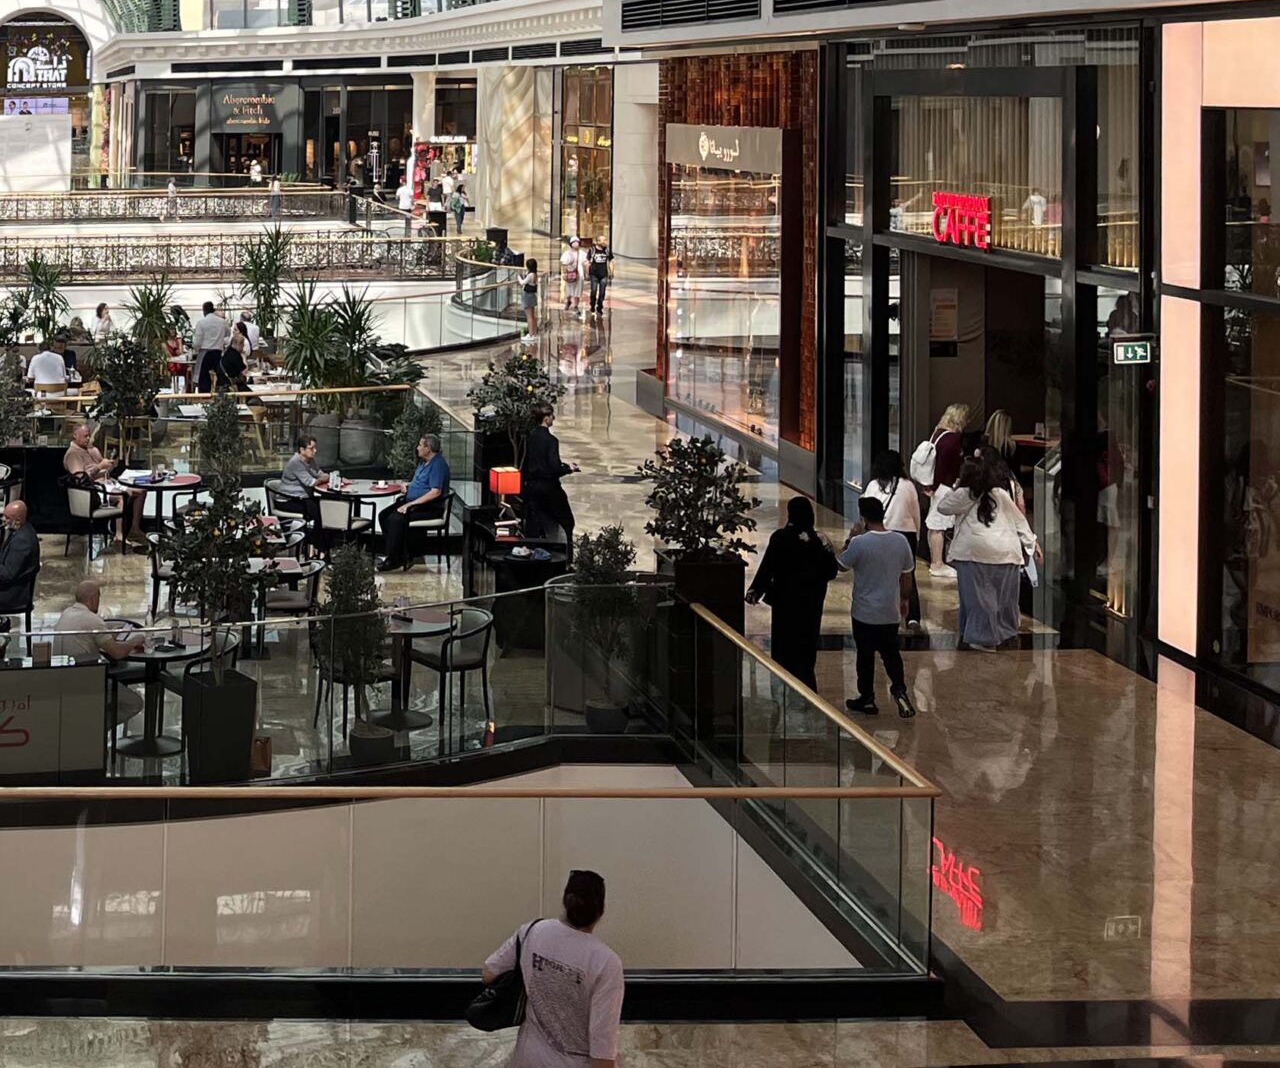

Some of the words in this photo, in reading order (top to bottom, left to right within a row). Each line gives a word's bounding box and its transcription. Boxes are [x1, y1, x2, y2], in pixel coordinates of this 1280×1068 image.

[36, 70, 67, 82] THAT
[223, 93, 276, 105] Abercrombie
[232, 107, 240, 115] &
[242, 105, 263, 116] Fitch
